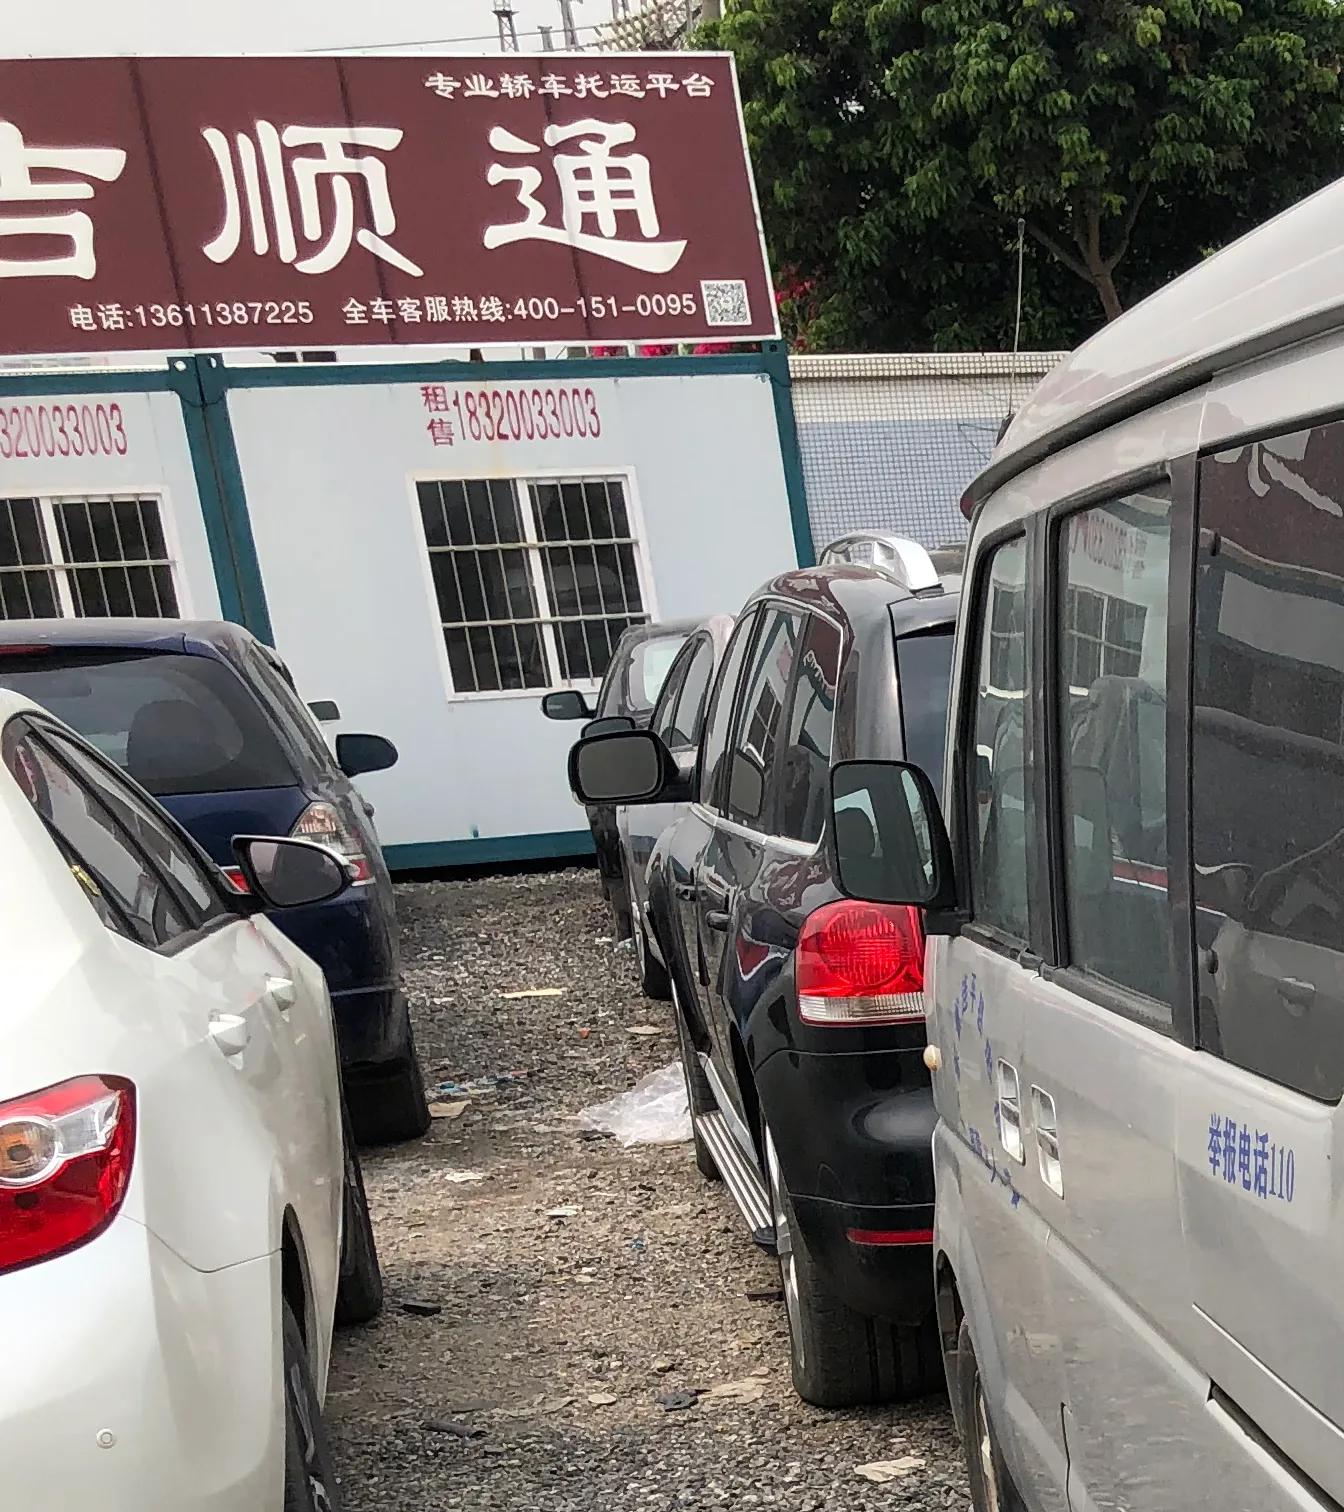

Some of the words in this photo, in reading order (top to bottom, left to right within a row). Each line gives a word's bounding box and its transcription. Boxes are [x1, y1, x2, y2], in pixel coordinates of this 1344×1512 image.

[424, 72, 715, 99] 专业轿车托运平台
[70, 300, 314, 332] 电话:13611387225
[341, 293, 697, 326] 全车客服热线:400-151-0095
[452, 387, 601, 441] 18320033003
[1207, 1111, 1295, 1203] 举报电话110
